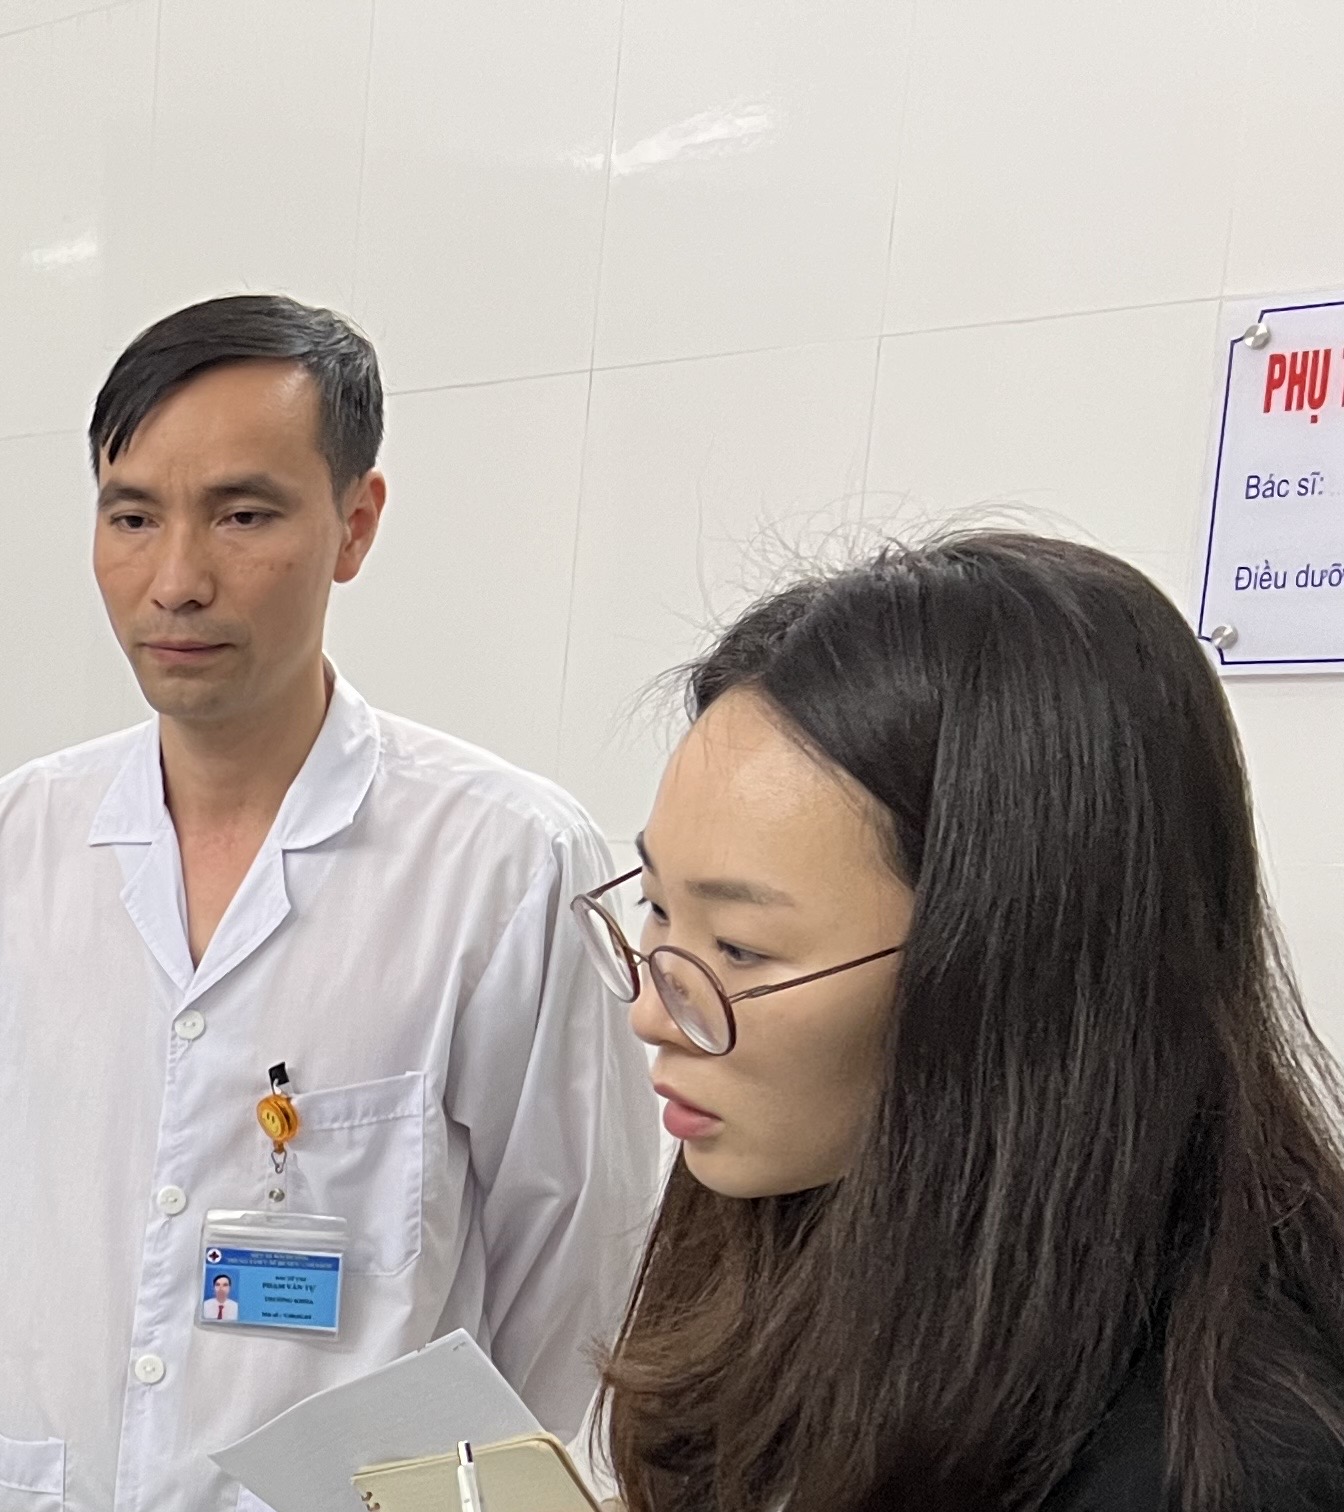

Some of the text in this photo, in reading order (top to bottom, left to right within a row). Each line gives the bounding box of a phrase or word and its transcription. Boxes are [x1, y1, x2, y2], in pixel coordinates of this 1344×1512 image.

[1263, 349, 1332, 424] PHỤ
[1245, 473, 1290, 500] Bác
[1235, 559, 1344, 591] Điều dưỡ
